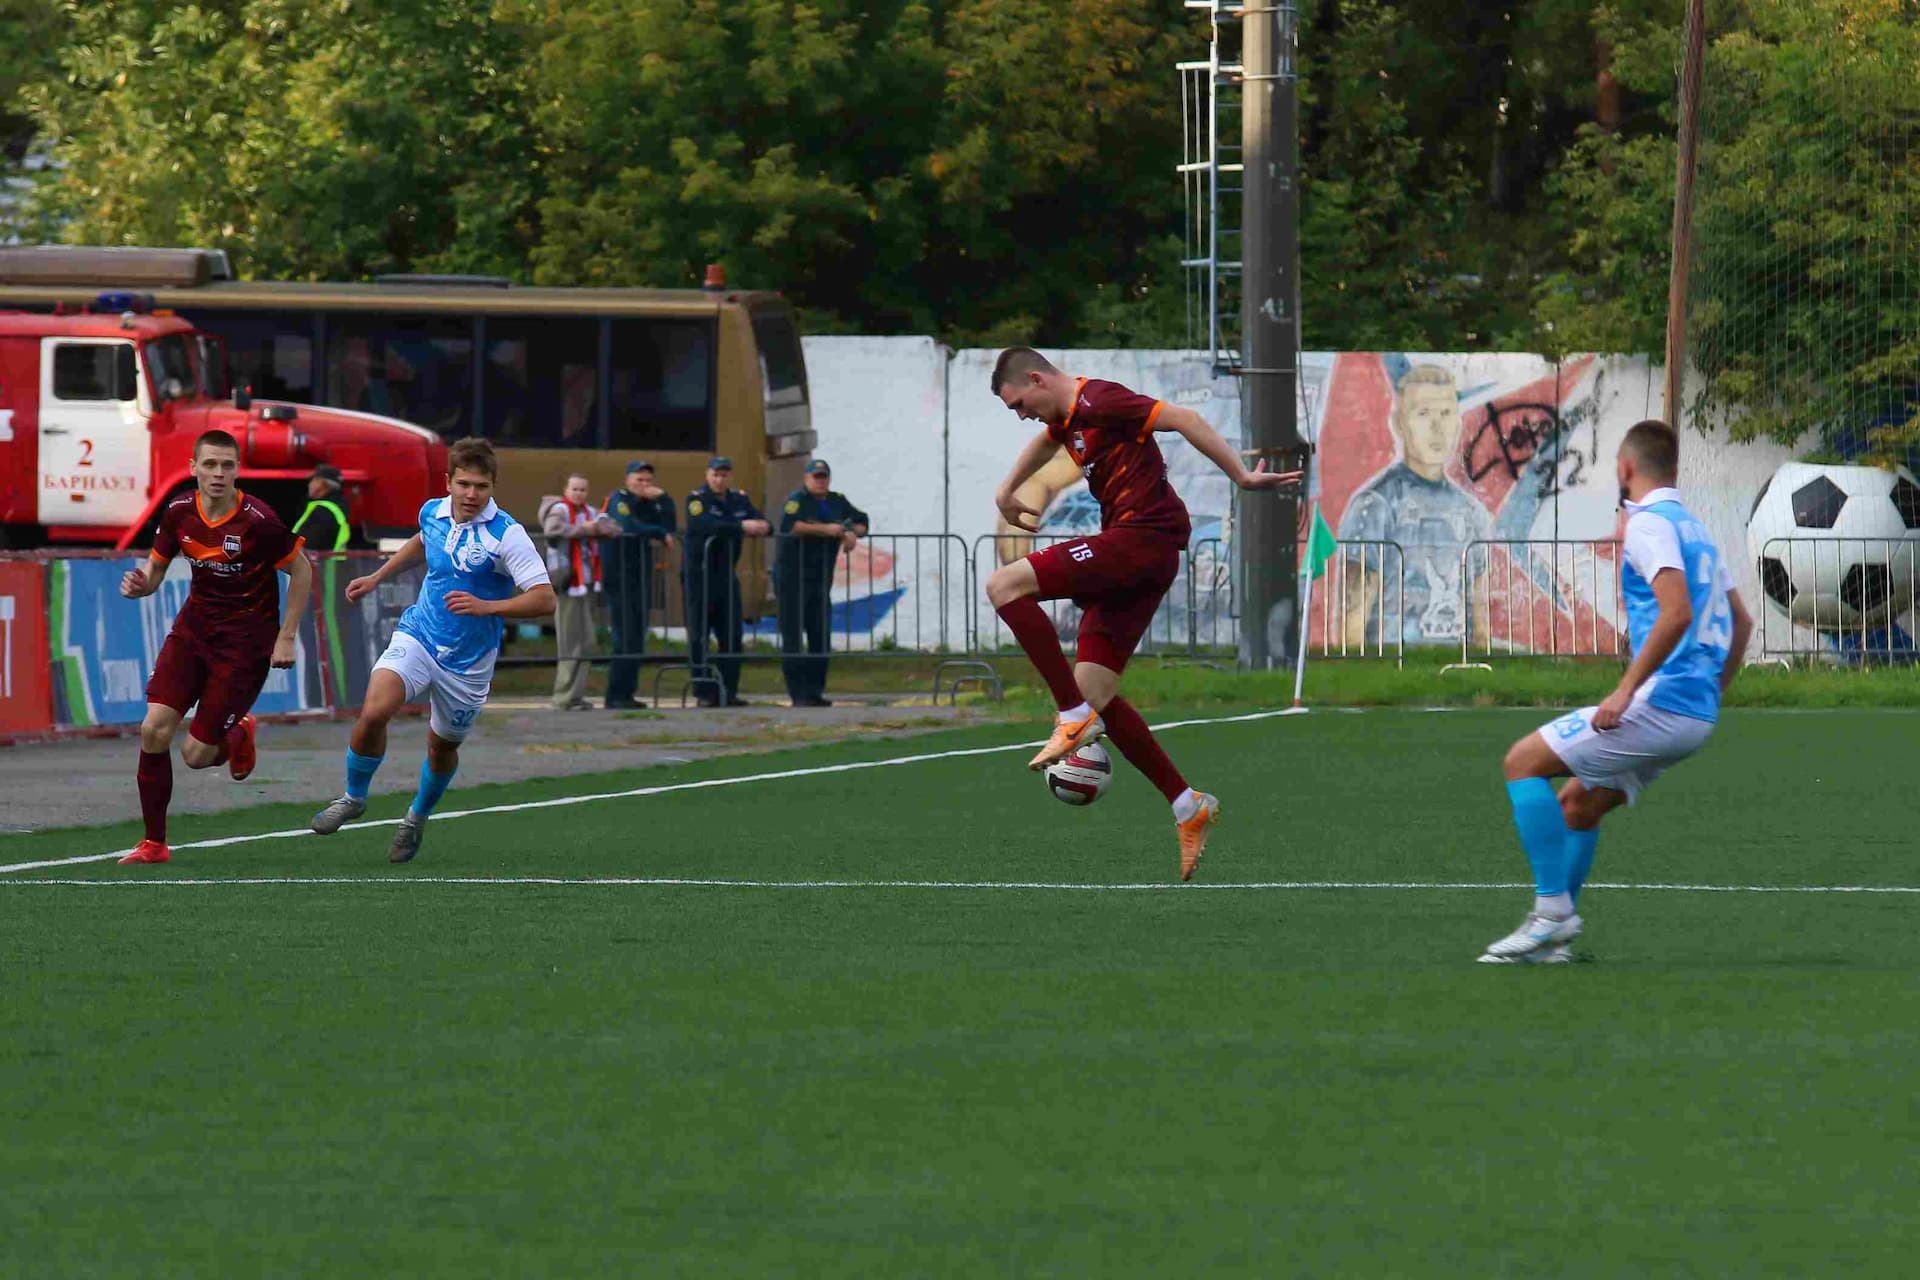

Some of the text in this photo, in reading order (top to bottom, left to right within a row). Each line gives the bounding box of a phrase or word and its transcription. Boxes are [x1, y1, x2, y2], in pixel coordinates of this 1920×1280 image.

[78, 439, 93, 467] 2
[44, 473, 136, 491] БАРНАУЛ
[1068, 542, 1094, 562] 15
[451, 709, 477, 728] 32
